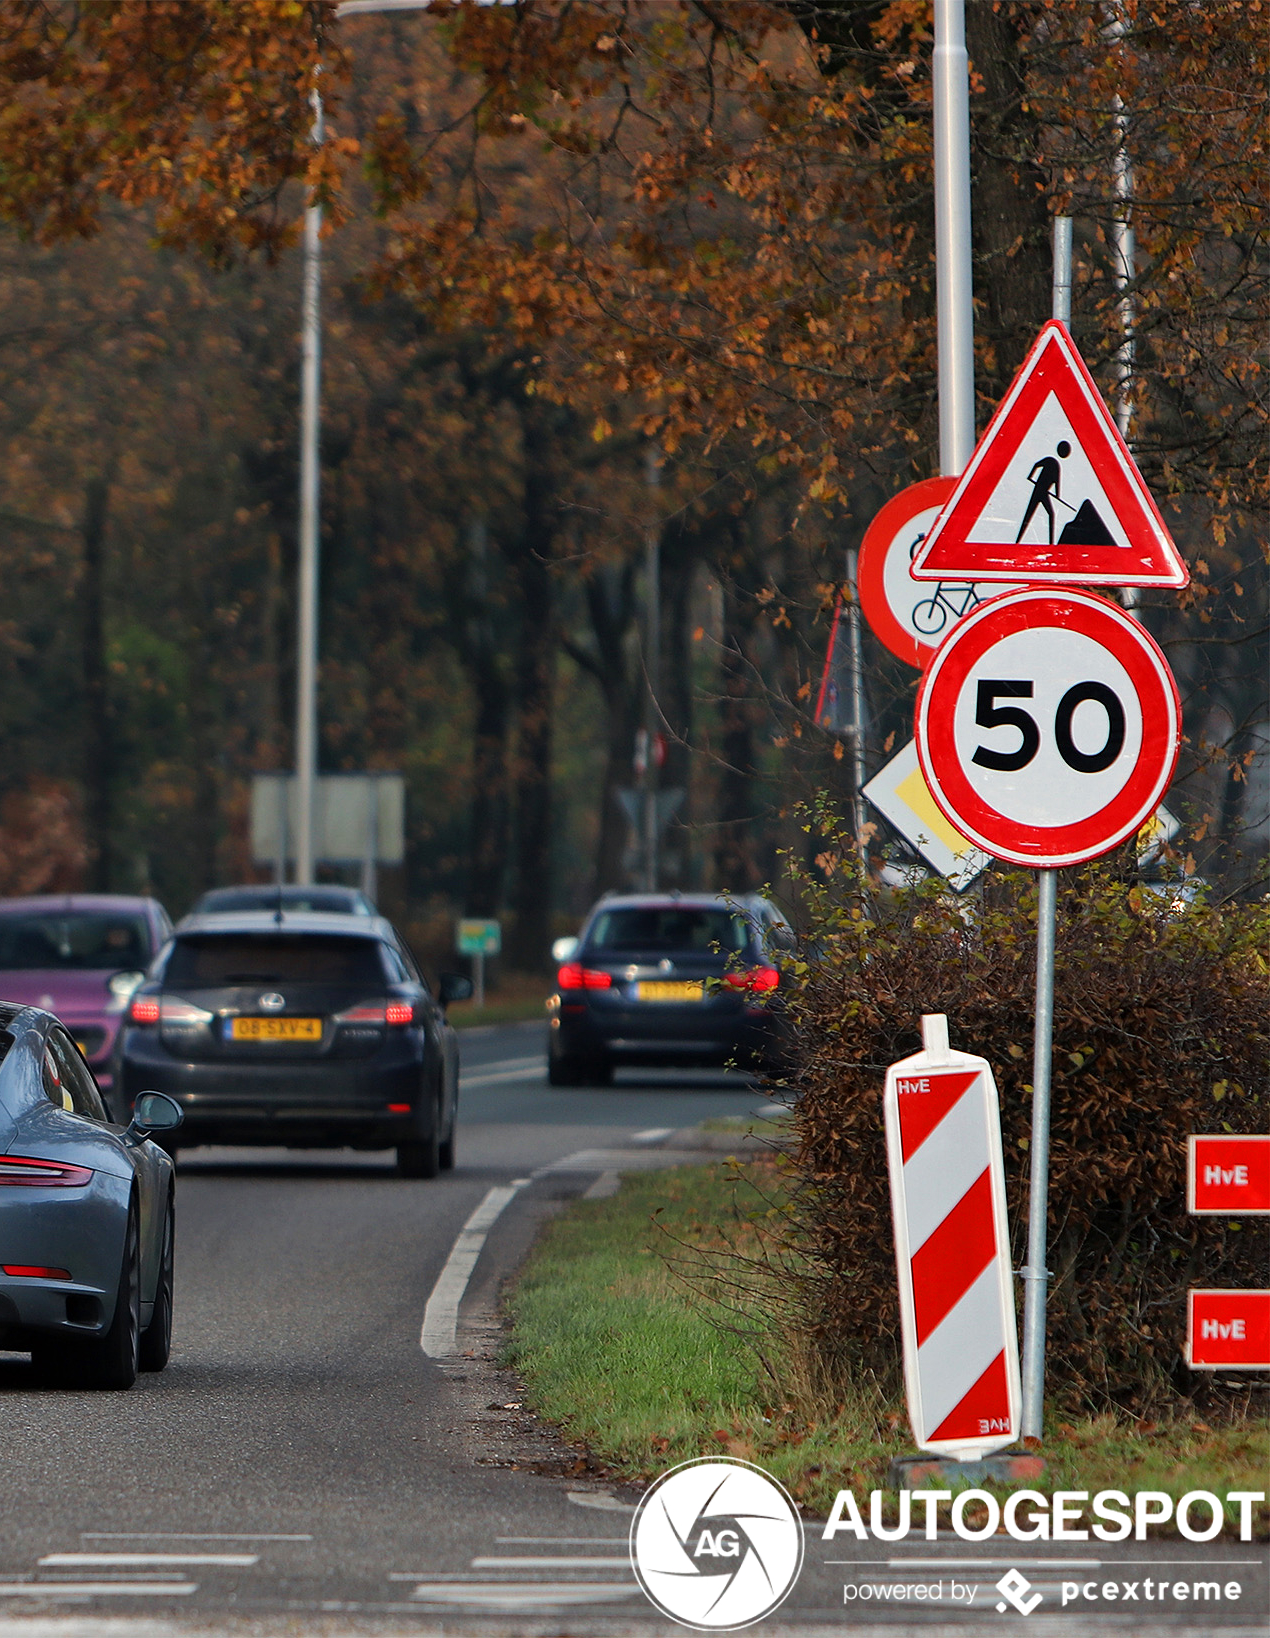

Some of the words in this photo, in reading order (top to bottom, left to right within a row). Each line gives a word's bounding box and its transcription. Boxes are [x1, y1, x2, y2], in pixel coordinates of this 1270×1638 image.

[971, 679, 1126, 774] 50
[897, 1078, 931, 1095] HvE
[1203, 1164, 1249, 1186] HvE
[1201, 1318, 1246, 1339] HvE
[978, 1417, 1010, 1434] HvE
